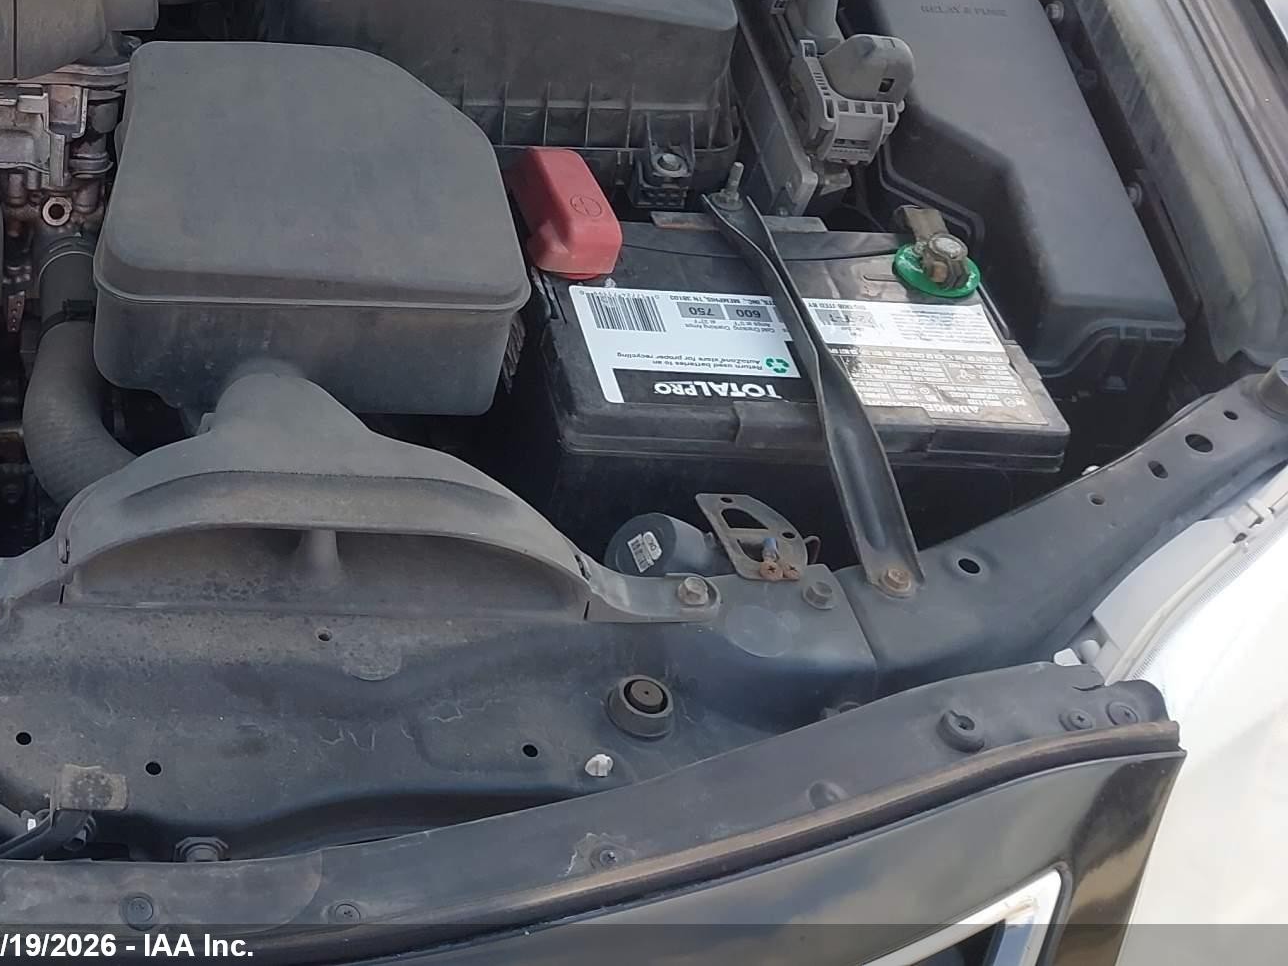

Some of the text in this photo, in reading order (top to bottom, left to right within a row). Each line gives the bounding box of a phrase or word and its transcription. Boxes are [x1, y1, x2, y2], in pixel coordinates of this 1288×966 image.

[688, 307, 715, 316] 750
[736, 309, 761, 318] 600
[616, 352, 654, 360] recycling
[675, 360, 711, 369] batteries
[653, 380, 785, 399] TOTALPRO
